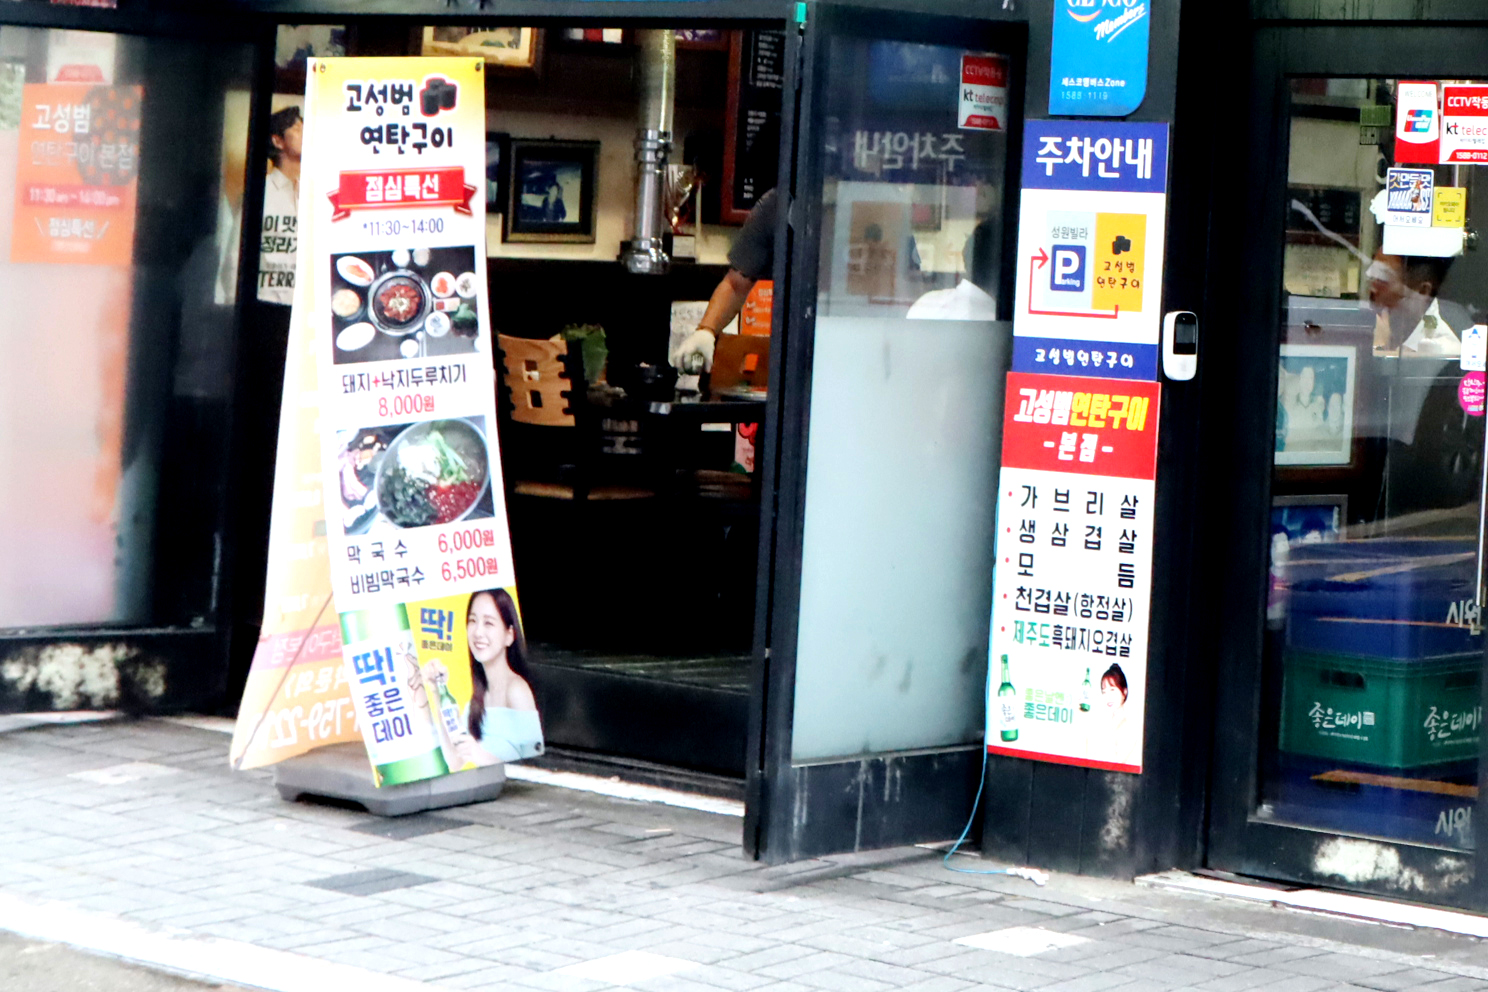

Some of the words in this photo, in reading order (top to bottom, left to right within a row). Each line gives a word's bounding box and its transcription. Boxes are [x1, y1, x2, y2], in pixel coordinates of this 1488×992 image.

[1093, 3, 1146, 41] Members
[345, 82, 414, 117] 고성범
[963, 88, 974, 102] kt
[31, 103, 92, 134] 고성범
[1445, 121, 1459, 136] kt
[359, 123, 454, 155] 연탄구이
[99, 143, 138, 169] 본점
[1035, 136, 1153, 179] 주차안내
[365, 173, 440, 202] 점심특선
[263, 215, 280, 233] 이
[1051, 225, 1089, 240] 성원빌라
[259, 270, 296, 288] TERR
[1103, 260, 1136, 273] 고성범
[1096, 276, 1141, 290] 연탄구이
[341, 363, 468, 395] 돼지+낙지두루치기
[378, 393, 435, 419] 8,000원
[437, 528, 496, 555] 6,000원
[350, 565, 426, 595] 비빔막국수
[440, 556, 499, 583] 6,500원
[419, 607, 454, 641] 딱!
[351, 646, 395, 687] 딱!
[362, 687, 405, 717] 좋은
[1023, 701, 1074, 725] 좋은데이
[1308, 701, 1362, 730] 좋은데이
[371, 712, 414, 745] 데이
[1423, 706, 1477, 742] 좋은데이
